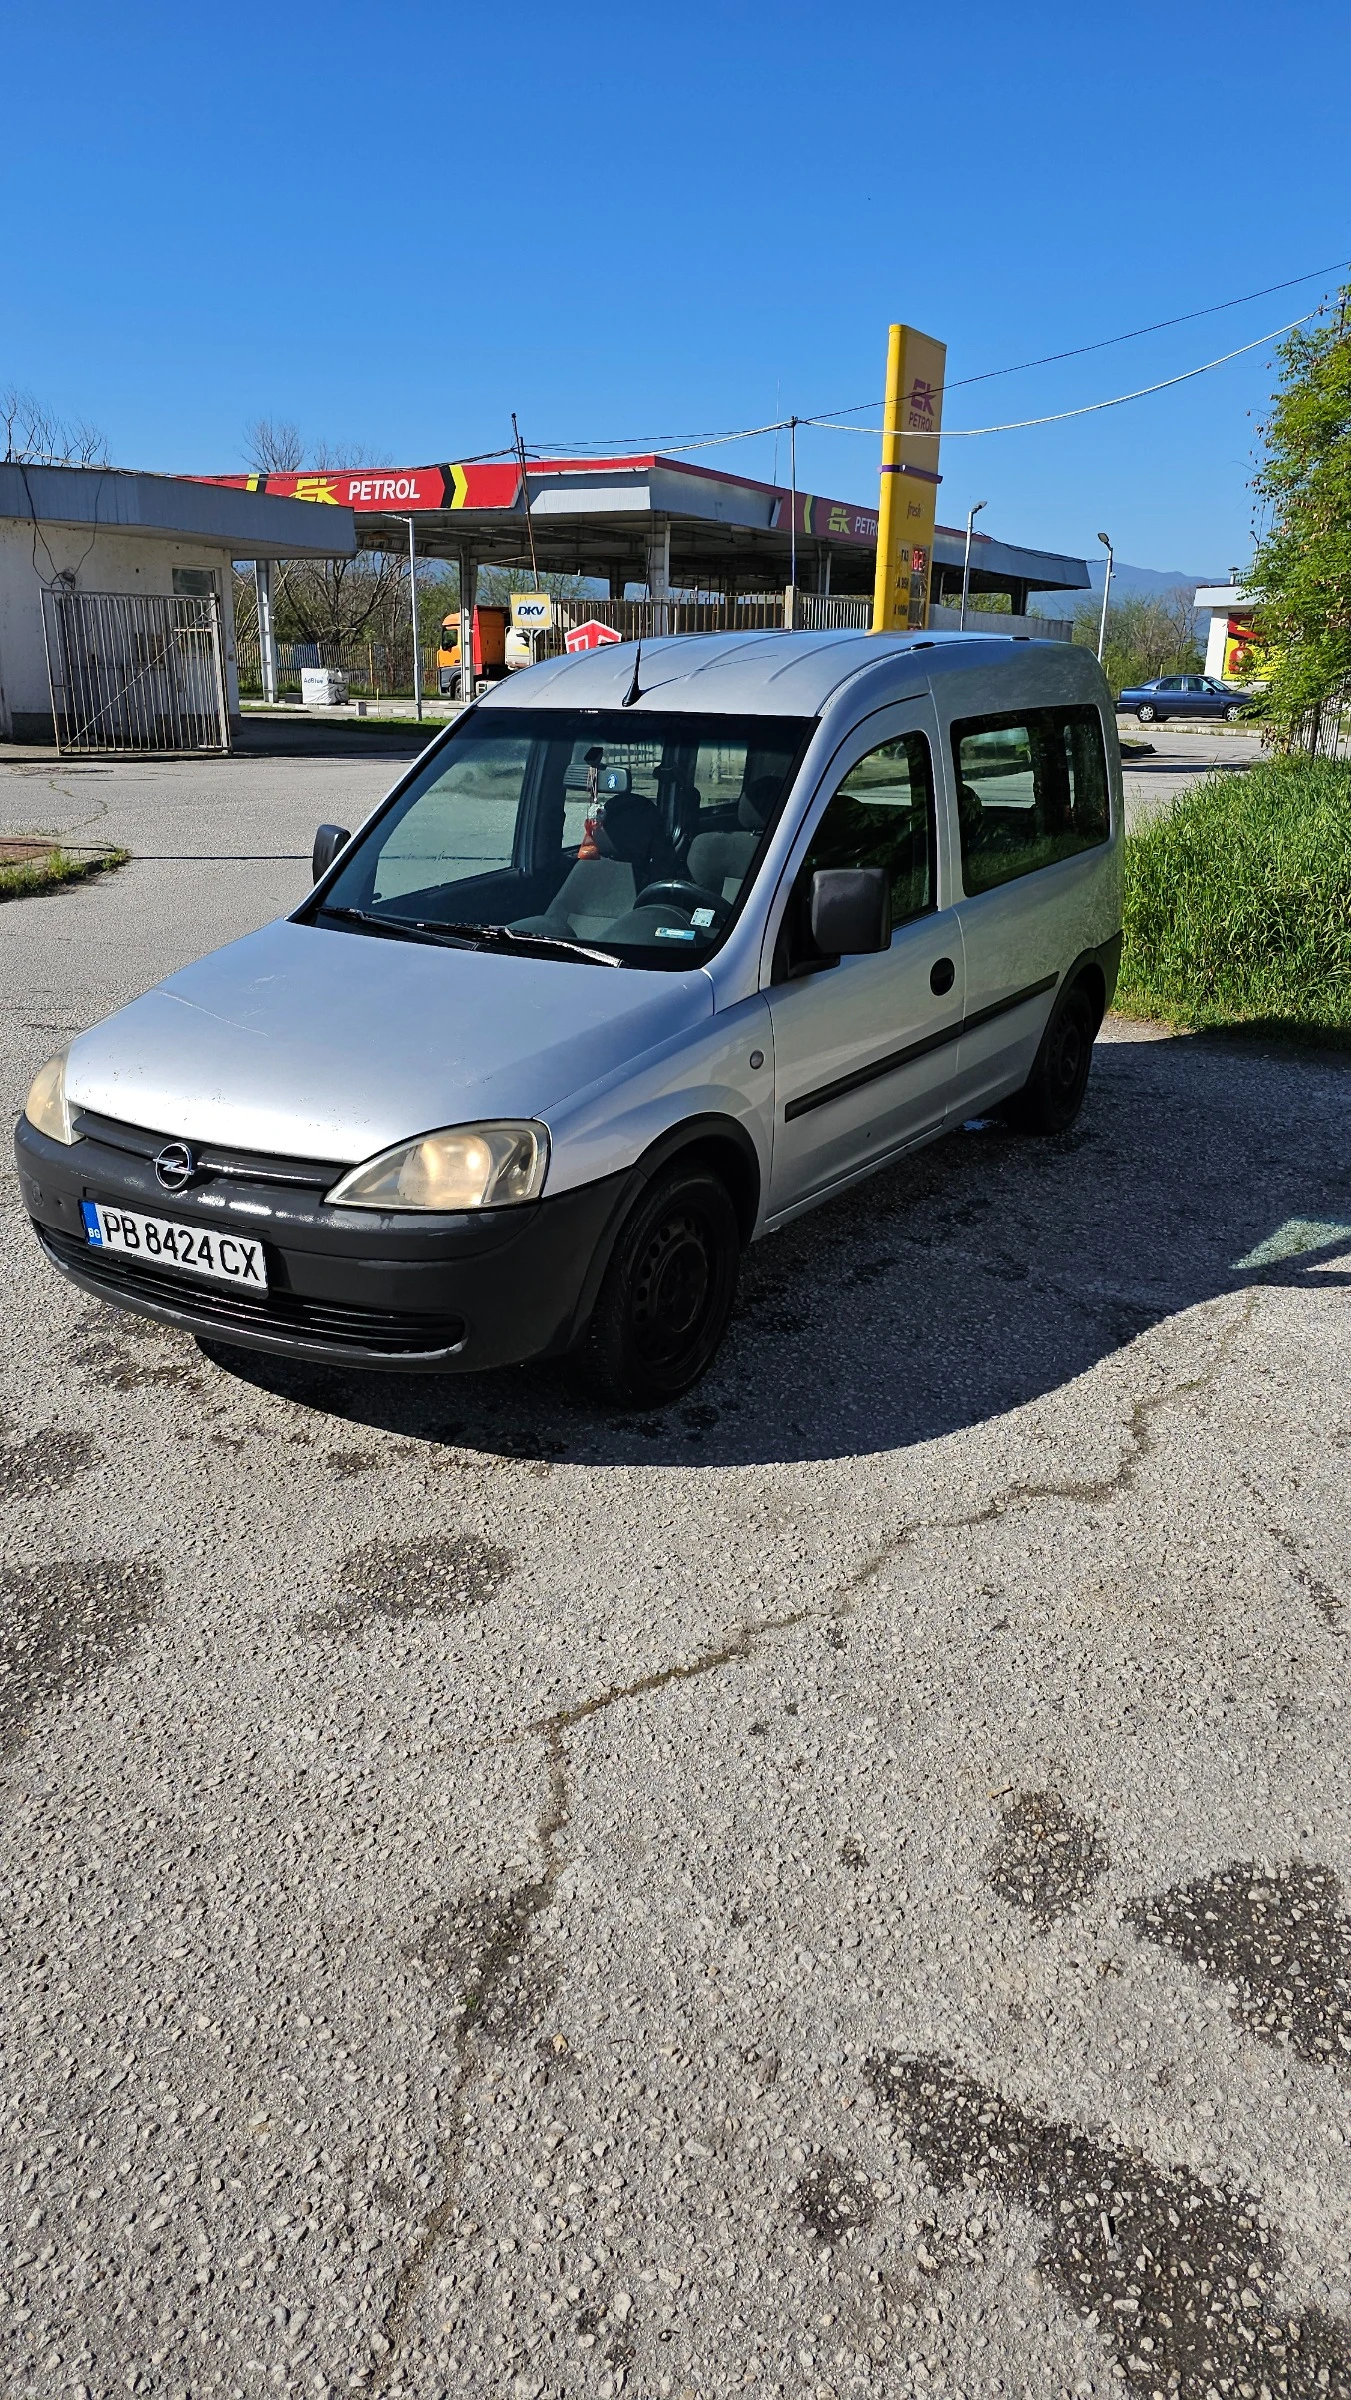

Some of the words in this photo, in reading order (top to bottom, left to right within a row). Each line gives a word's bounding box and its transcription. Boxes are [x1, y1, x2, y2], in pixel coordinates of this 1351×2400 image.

[908, 411, 934, 432] PETROL
[348, 478, 421, 501] PETROL
[854, 516, 879, 537] PETR
[517, 606, 546, 616] DKV
[87, 1227, 101, 1239] BG
[103, 1212, 140, 1248] PB
[144, 1222, 214, 1270] 8424
[219, 1239, 261, 1281] CX
